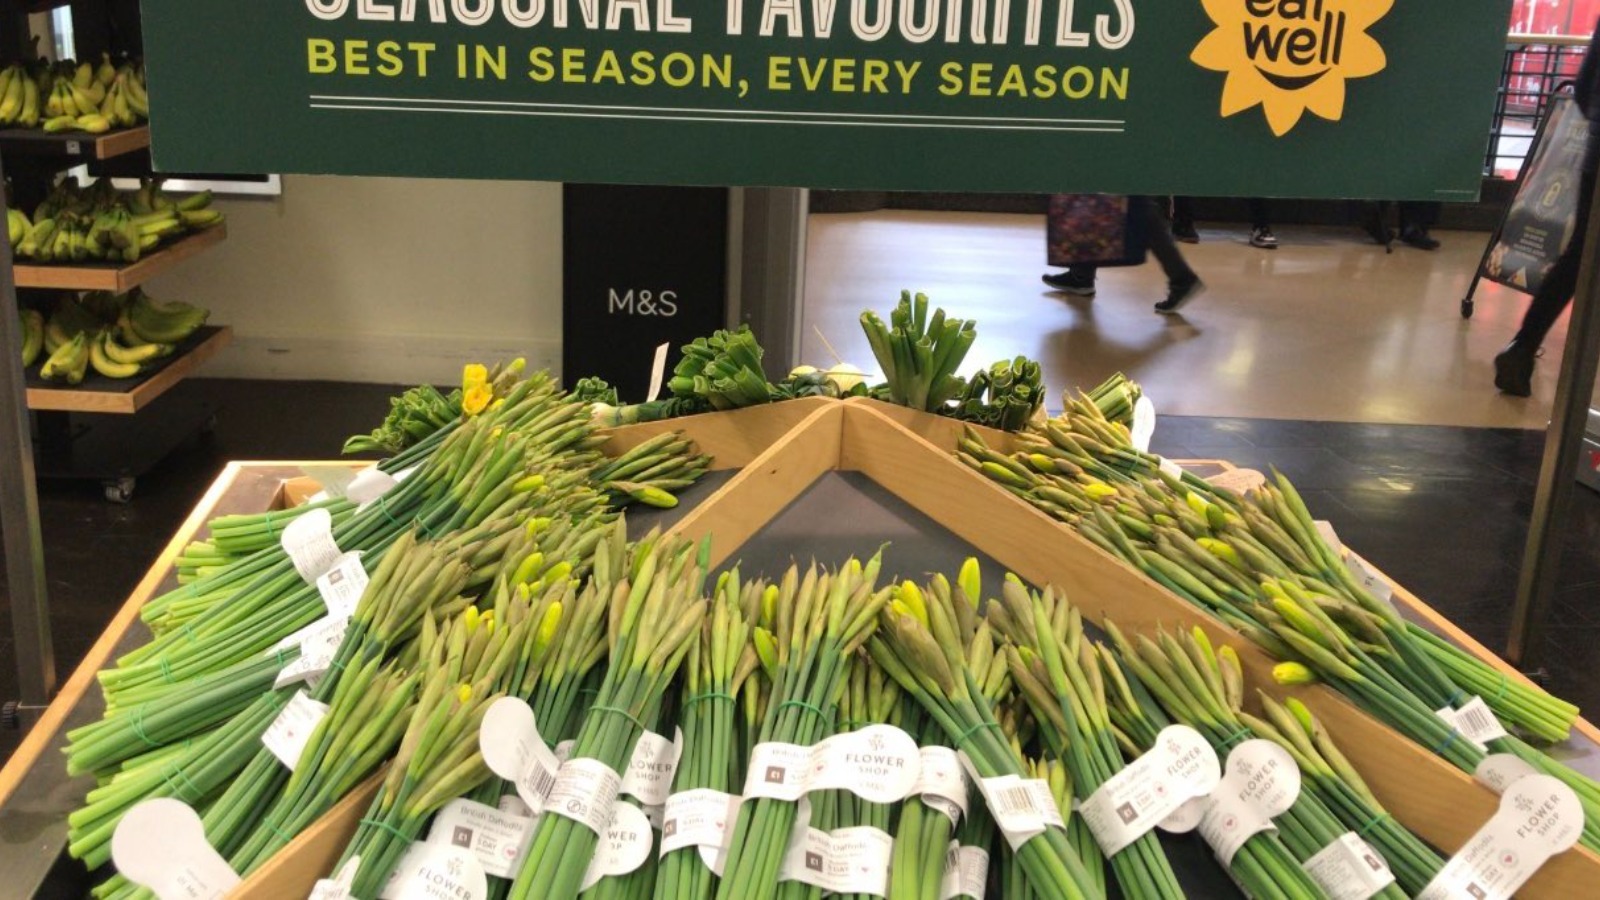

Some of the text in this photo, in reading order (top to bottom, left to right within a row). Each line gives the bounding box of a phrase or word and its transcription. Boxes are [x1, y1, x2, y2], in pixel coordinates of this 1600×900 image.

[1243, 10, 1346, 66] well
[307, 38, 1130, 100] BEST IN SEASON, EVERY SEASON
[608, 288, 678, 317] M&S
[630, 761, 673, 773] LOWER
[845, 753, 905, 769] FLOWER
[859, 767, 889, 777] SHOP
[1167, 746, 1202, 777] FLOWER
[635, 771, 661, 782] SHOP
[1239, 758, 1278, 803] FLOWER
[1254, 776, 1275, 800] SHOP
[1516, 793, 1561, 839] FLOWER
[1537, 812, 1560, 837] SHOP
[418, 867, 472, 900] FLOWER
